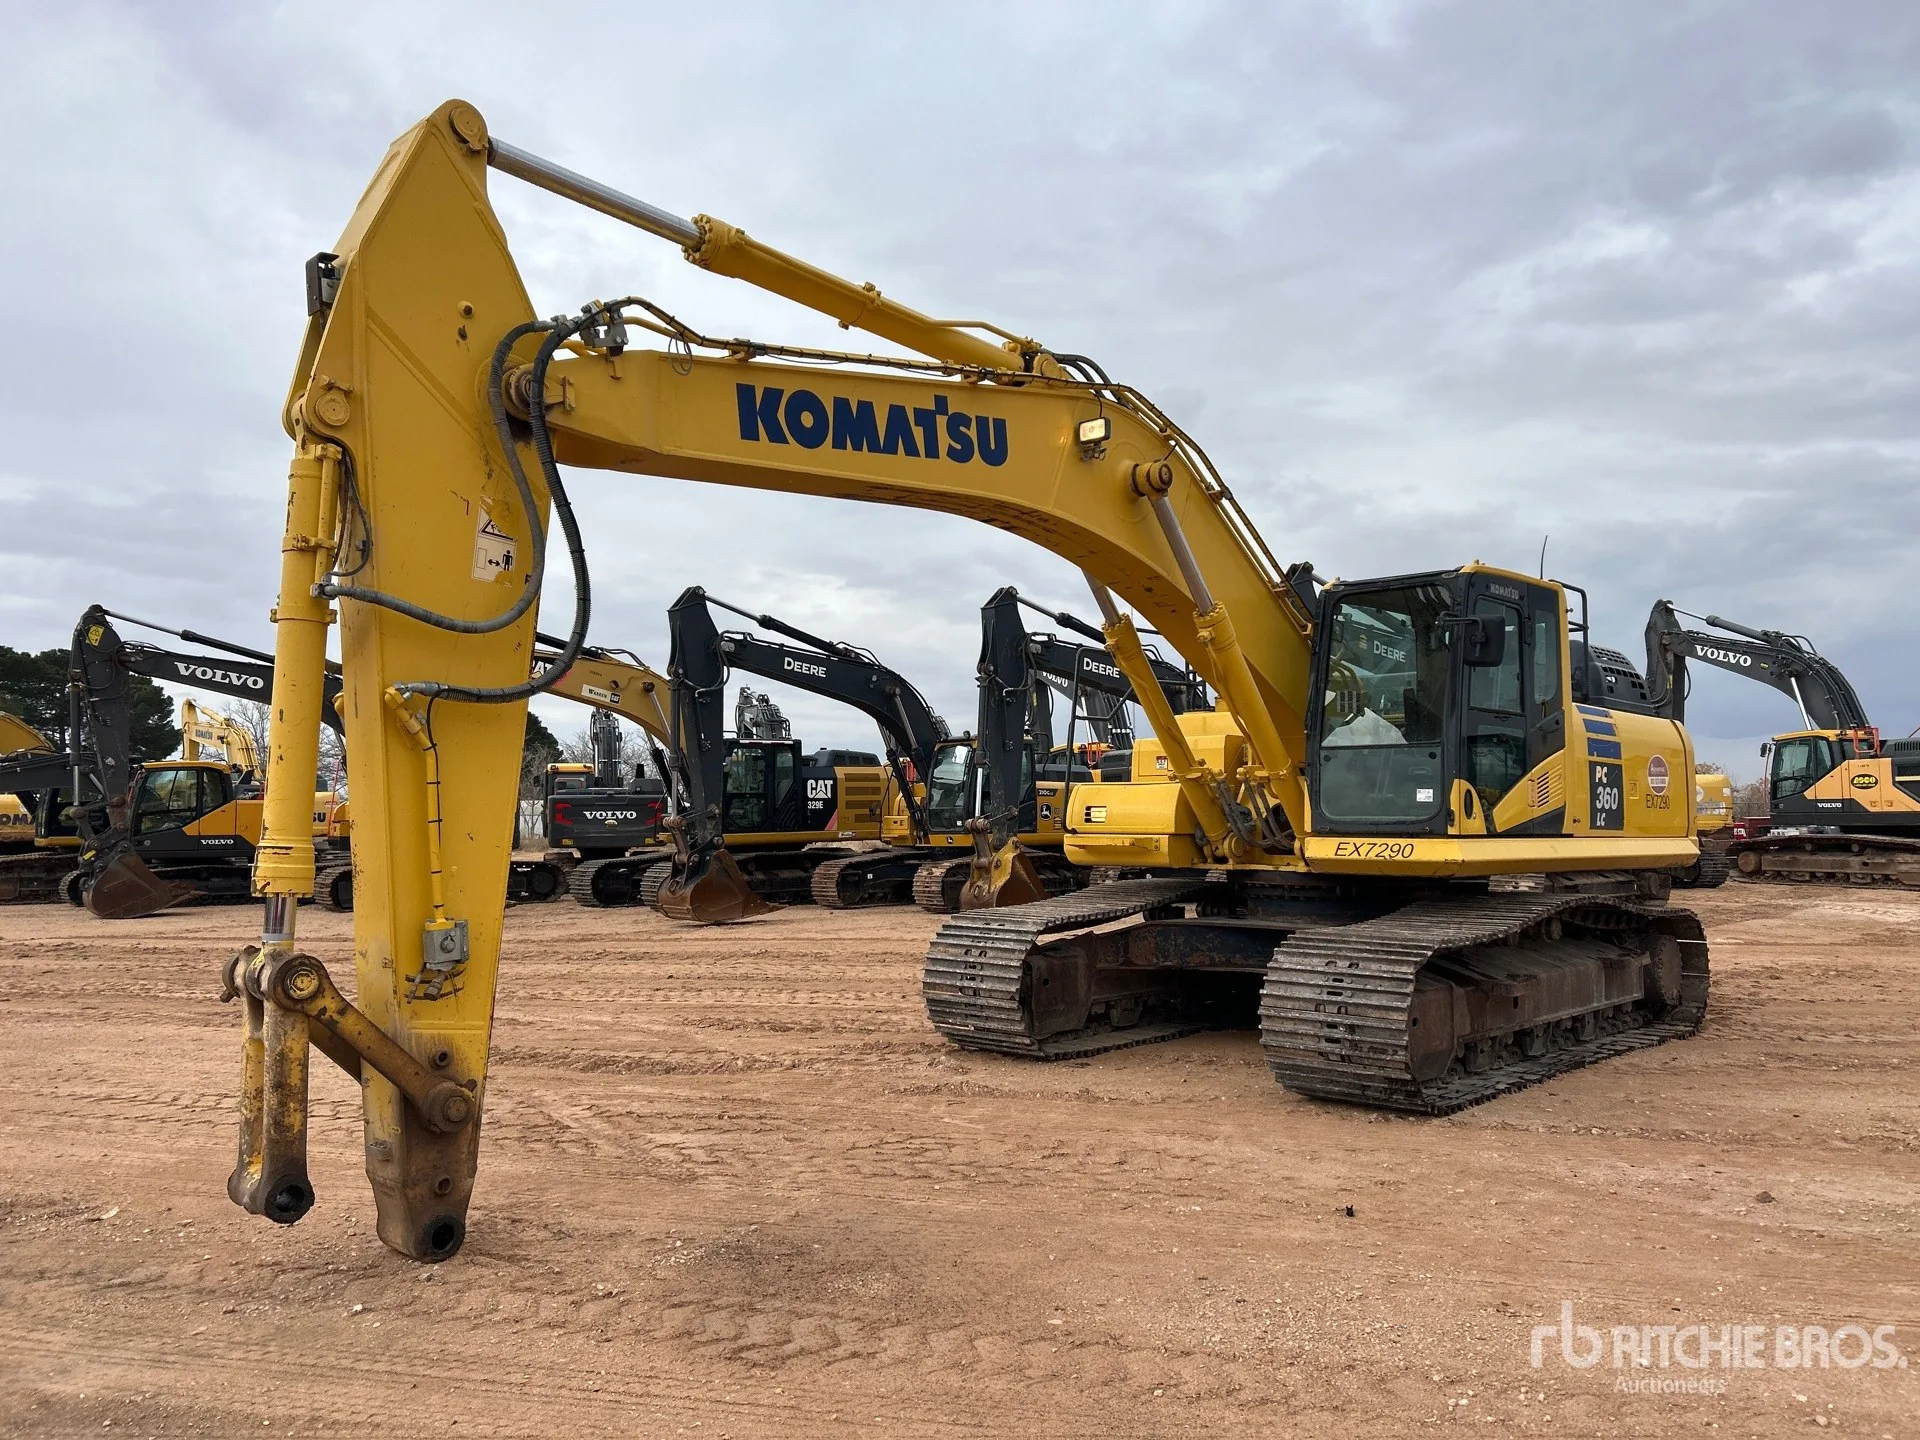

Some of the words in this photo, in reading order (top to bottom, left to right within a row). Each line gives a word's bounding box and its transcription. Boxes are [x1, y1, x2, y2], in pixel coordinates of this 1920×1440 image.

[736, 383, 1009, 467] KOMATSU
[1490, 583, 1520, 600] KOMATSU
[1373, 640, 1406, 663] DEERE
[1695, 644, 1752, 667] VOLVO
[174, 661, 264, 689] VOLVO
[783, 656, 827, 678] DEERE
[1083, 657, 1121, 679] DEERE
[1595, 765, 1608, 783] PC
[1853, 776, 1876, 784] ASCO
[807, 779, 834, 799] CAT
[1595, 786, 1619, 810] 360
[807, 800, 824, 809] 329E
[1645, 794, 1671, 810] EX7290
[583, 811, 637, 820] VOLVO
[1596, 812, 1606, 827] LC
[1334, 841, 1414, 858] EX7290
